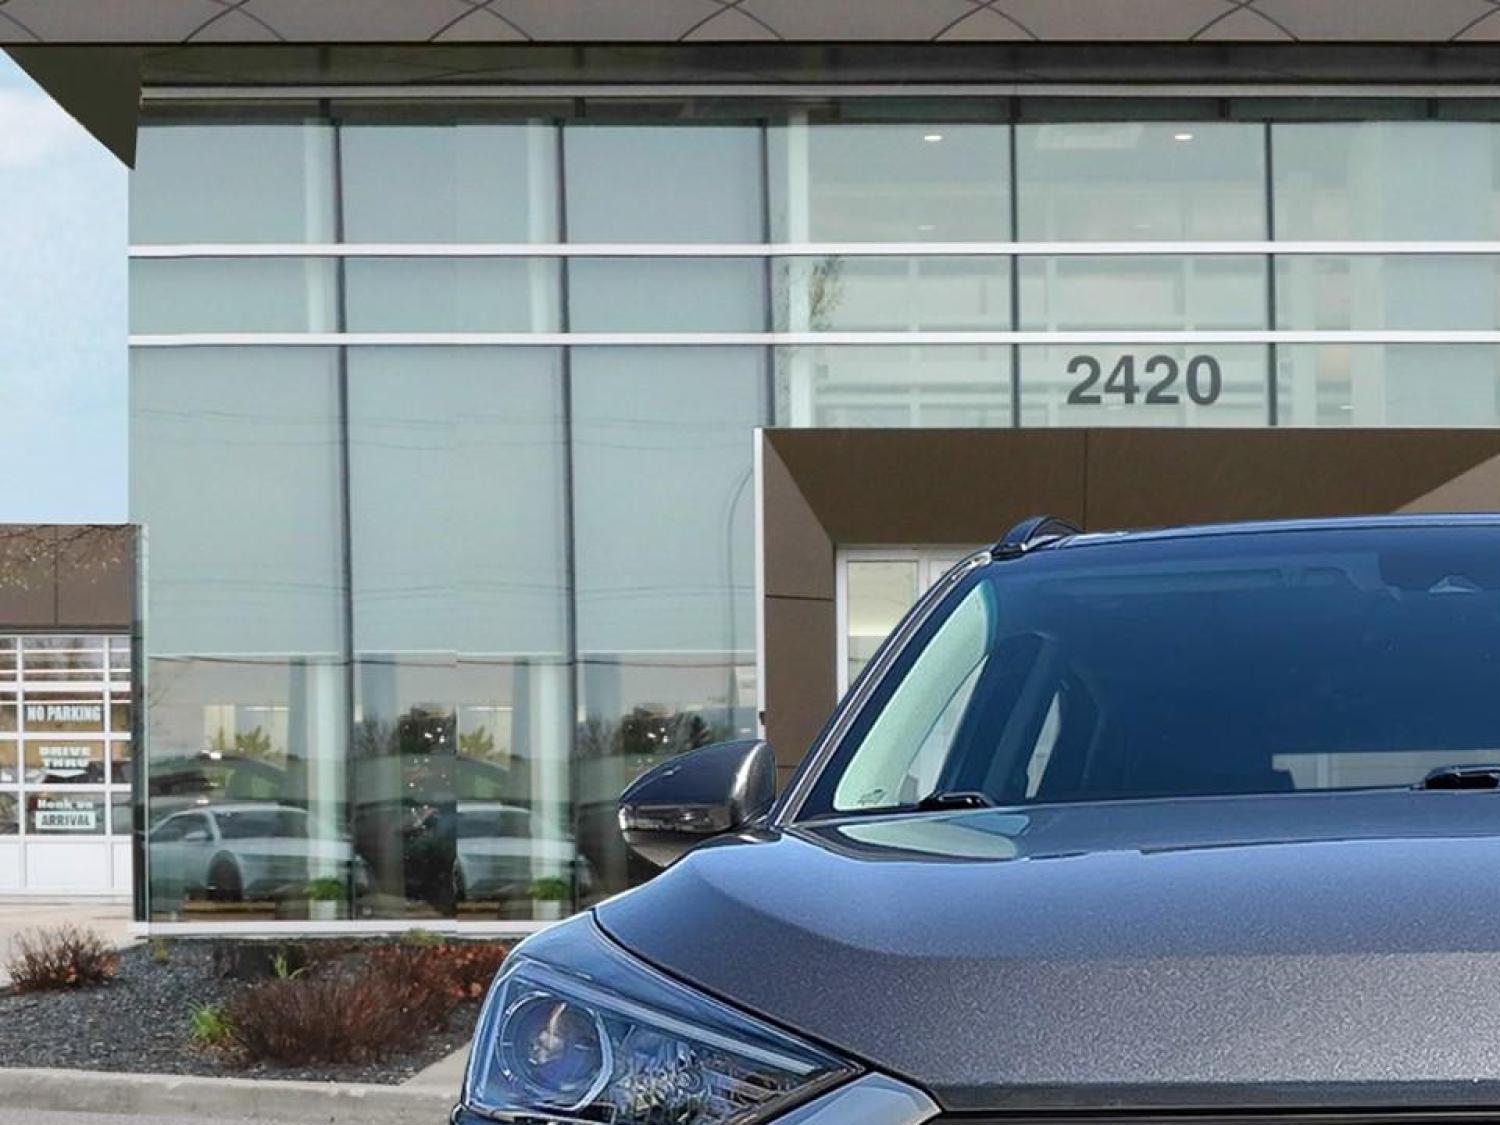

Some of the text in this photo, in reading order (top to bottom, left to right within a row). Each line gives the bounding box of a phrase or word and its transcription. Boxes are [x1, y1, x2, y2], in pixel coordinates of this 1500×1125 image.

[1066, 354, 1222, 406] 2420
[27, 705, 101, 721] NO PARKING
[41, 815, 91, 826] ARRIVAL
